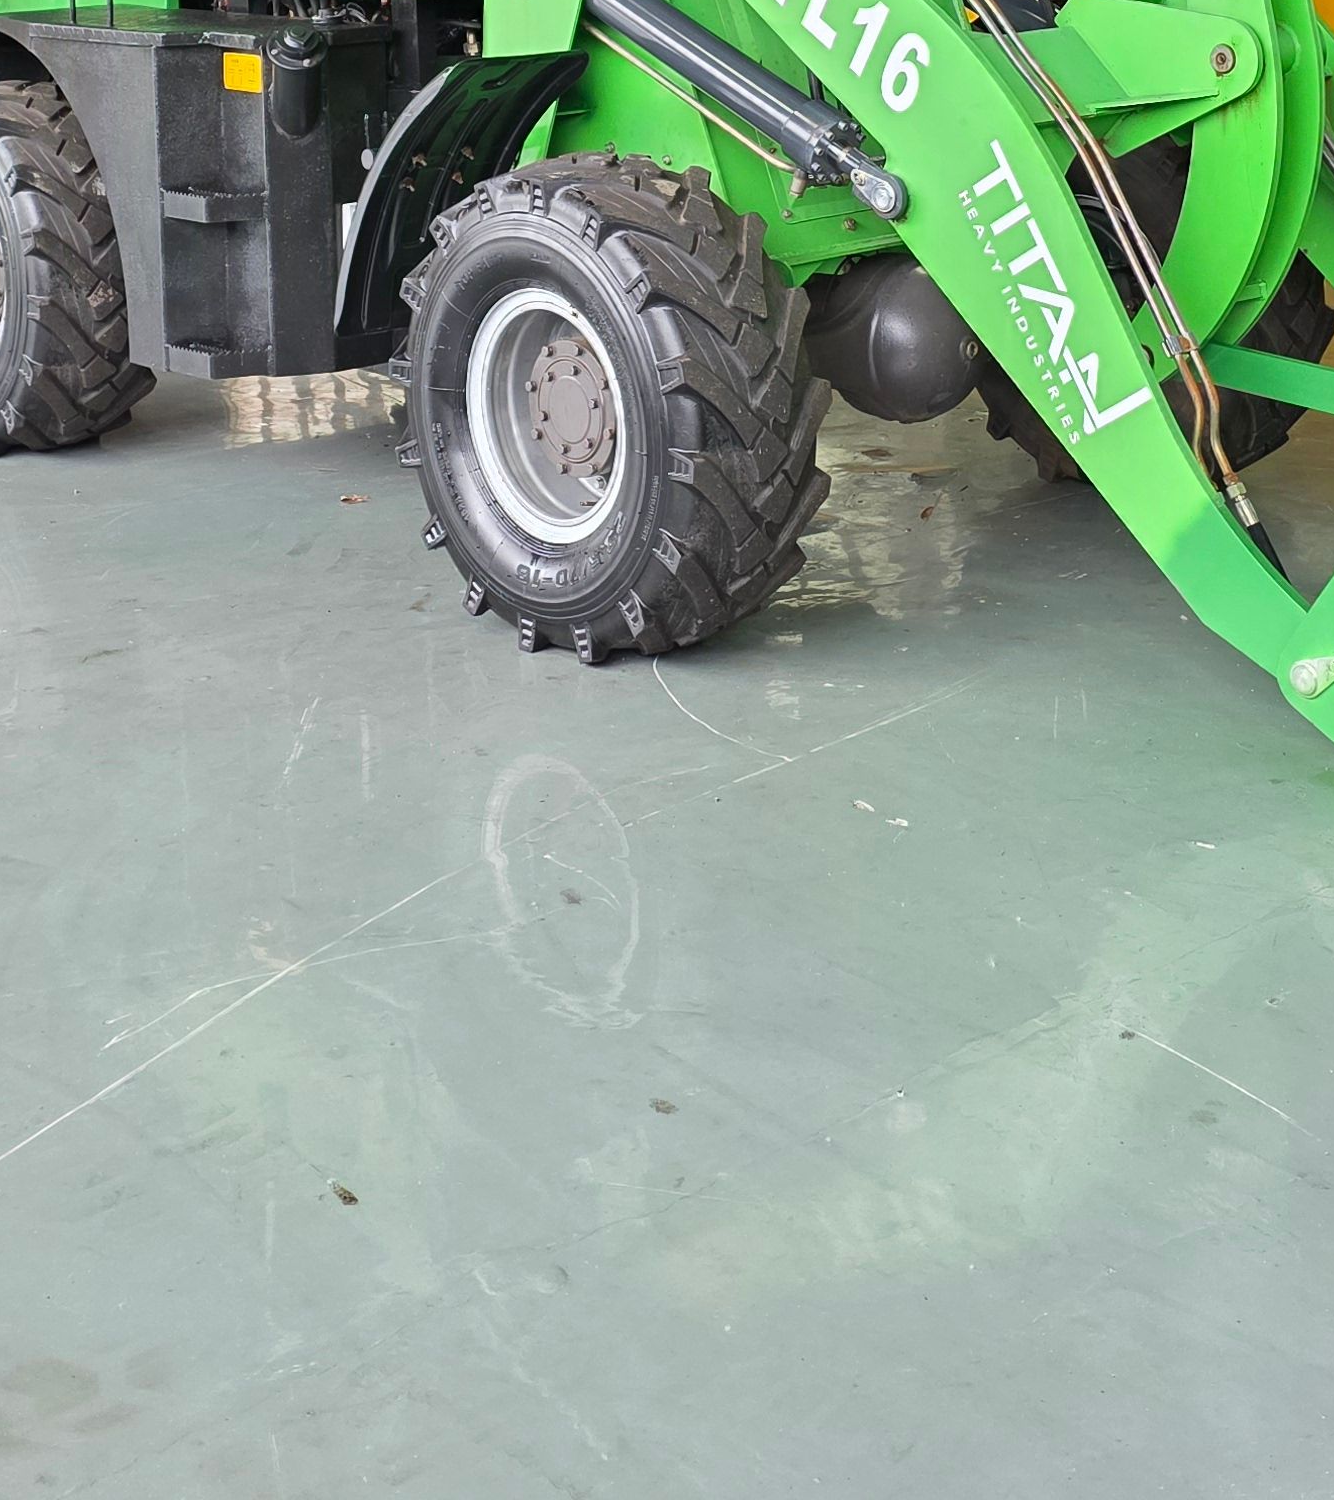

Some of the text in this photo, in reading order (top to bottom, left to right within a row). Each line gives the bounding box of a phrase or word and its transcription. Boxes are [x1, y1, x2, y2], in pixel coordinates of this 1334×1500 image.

[958, 189, 1081, 445] HEAVY INDUSTRIES
[972, 139, 1154, 436] TITAN
